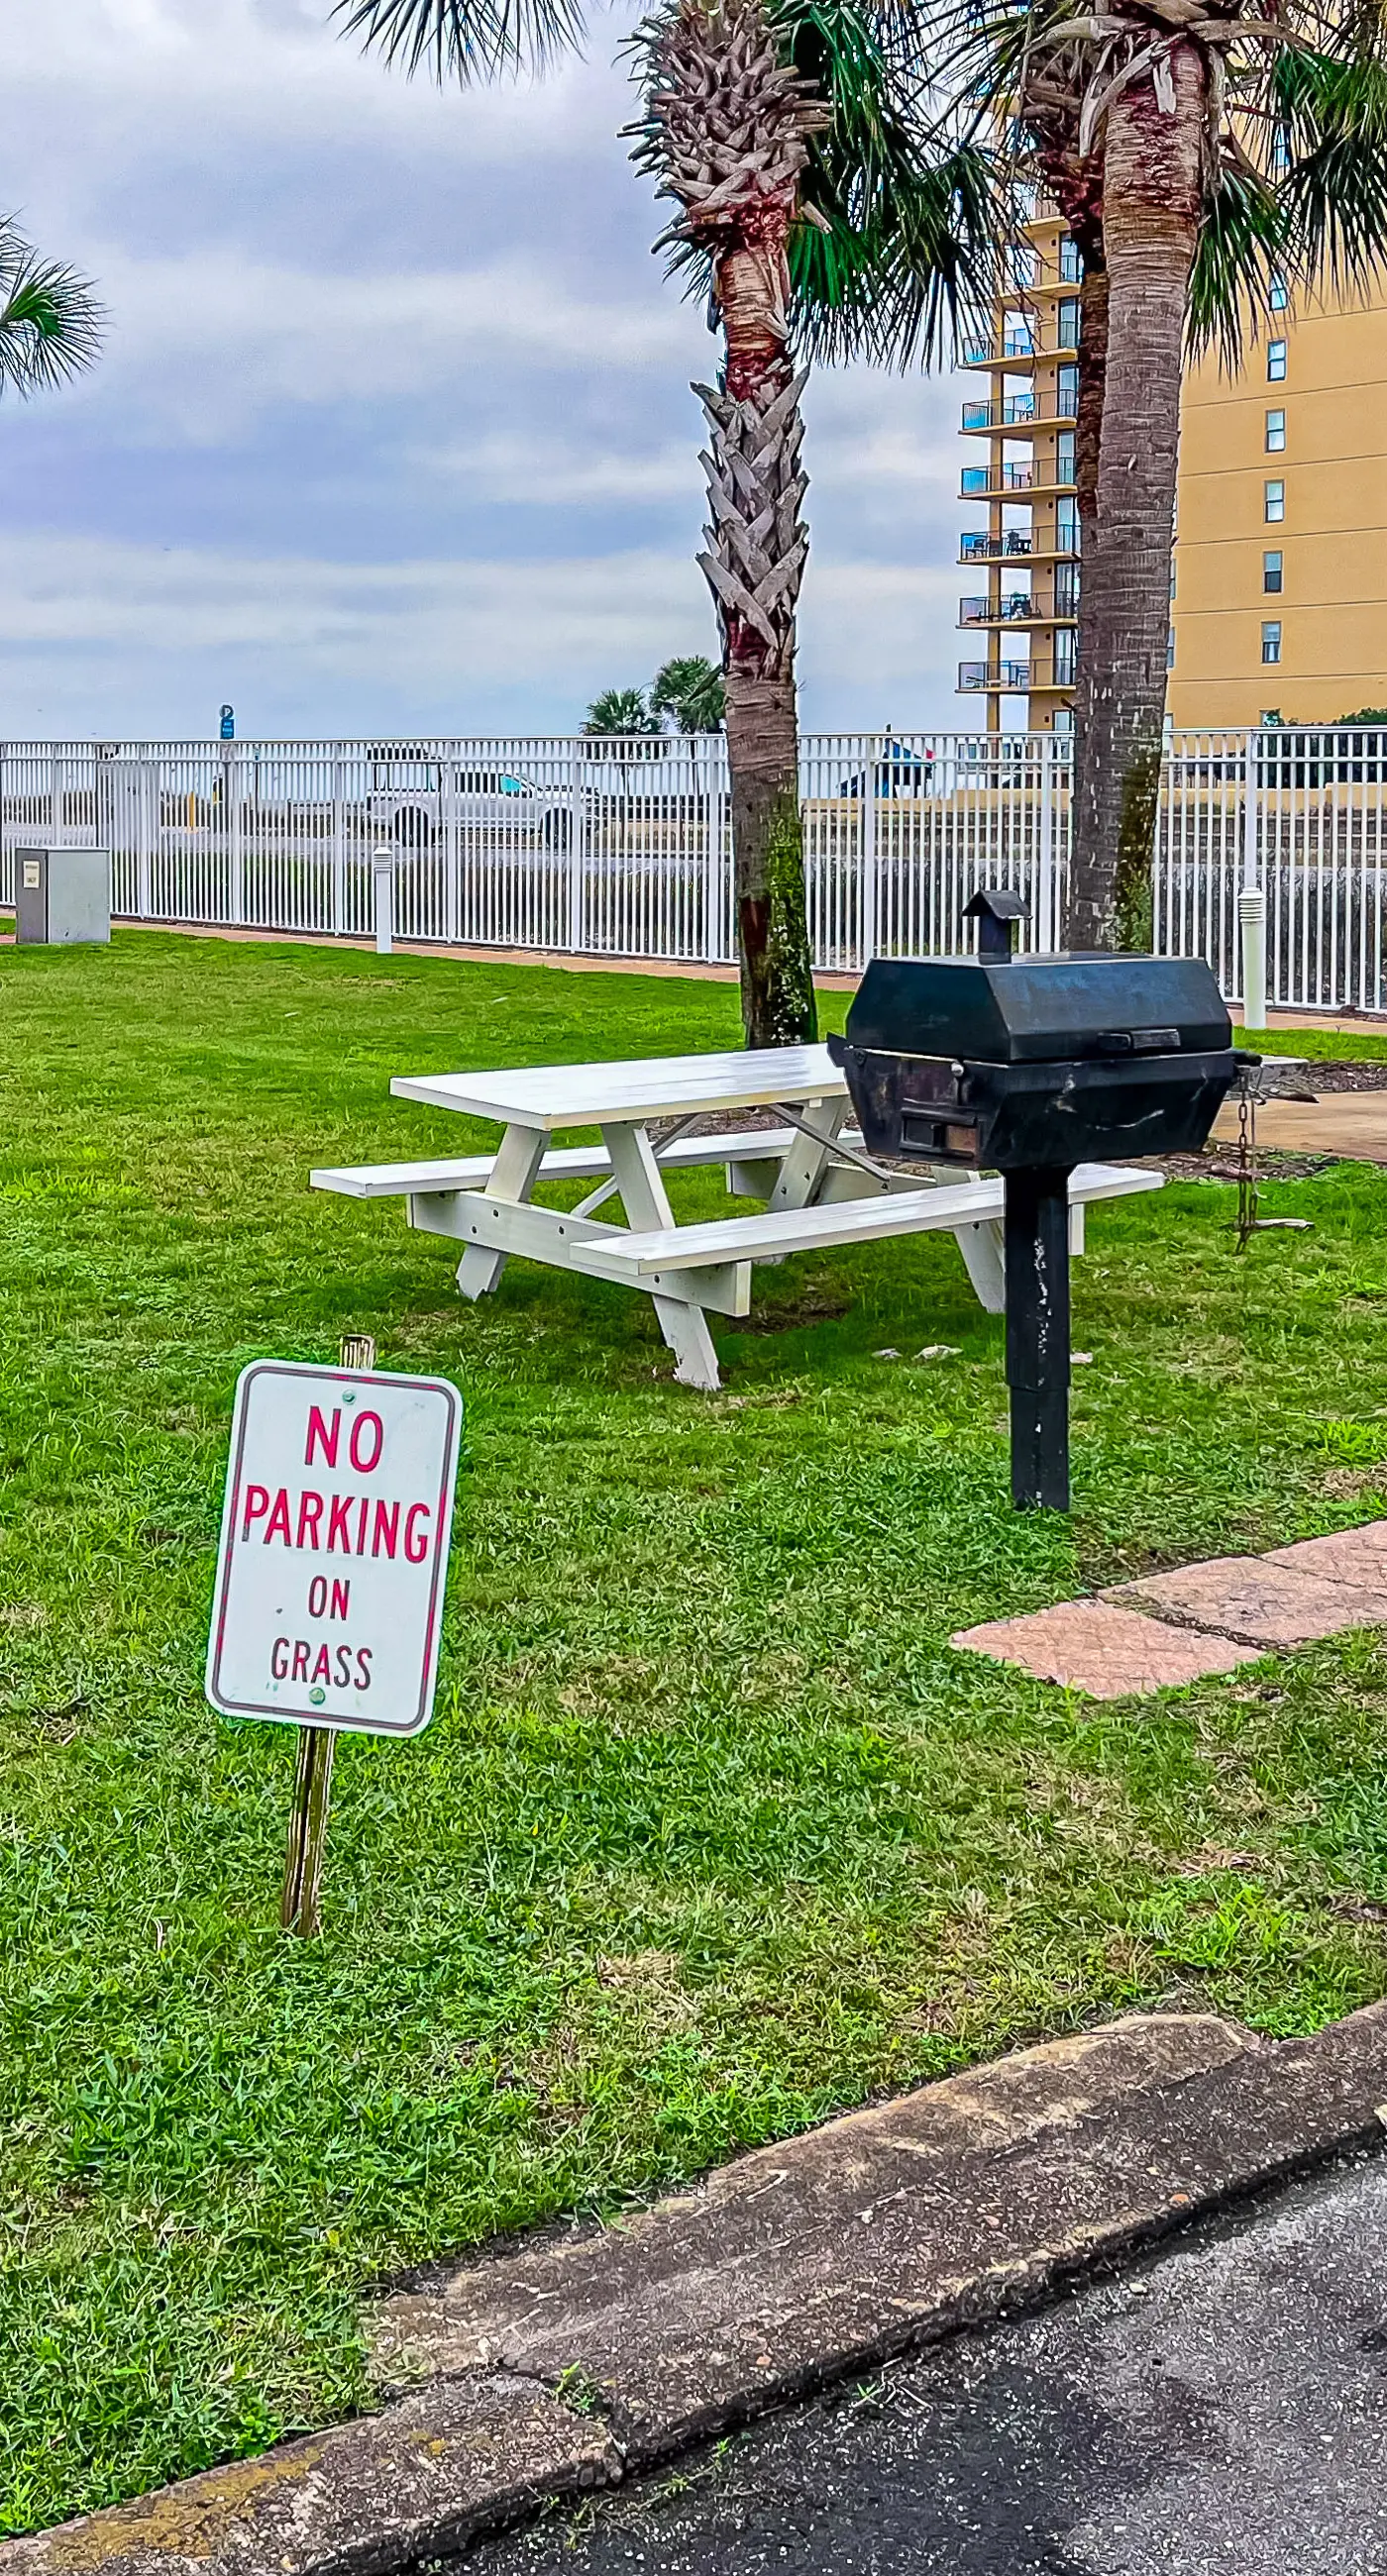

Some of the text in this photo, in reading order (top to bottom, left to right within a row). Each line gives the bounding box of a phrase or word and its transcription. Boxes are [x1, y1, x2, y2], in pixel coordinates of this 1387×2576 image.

[304, 1404, 384, 1474] NO
[241, 1484, 431, 1565] PARKING
[308, 1575, 351, 1621] ON
[270, 1637, 373, 1691] GRASS
